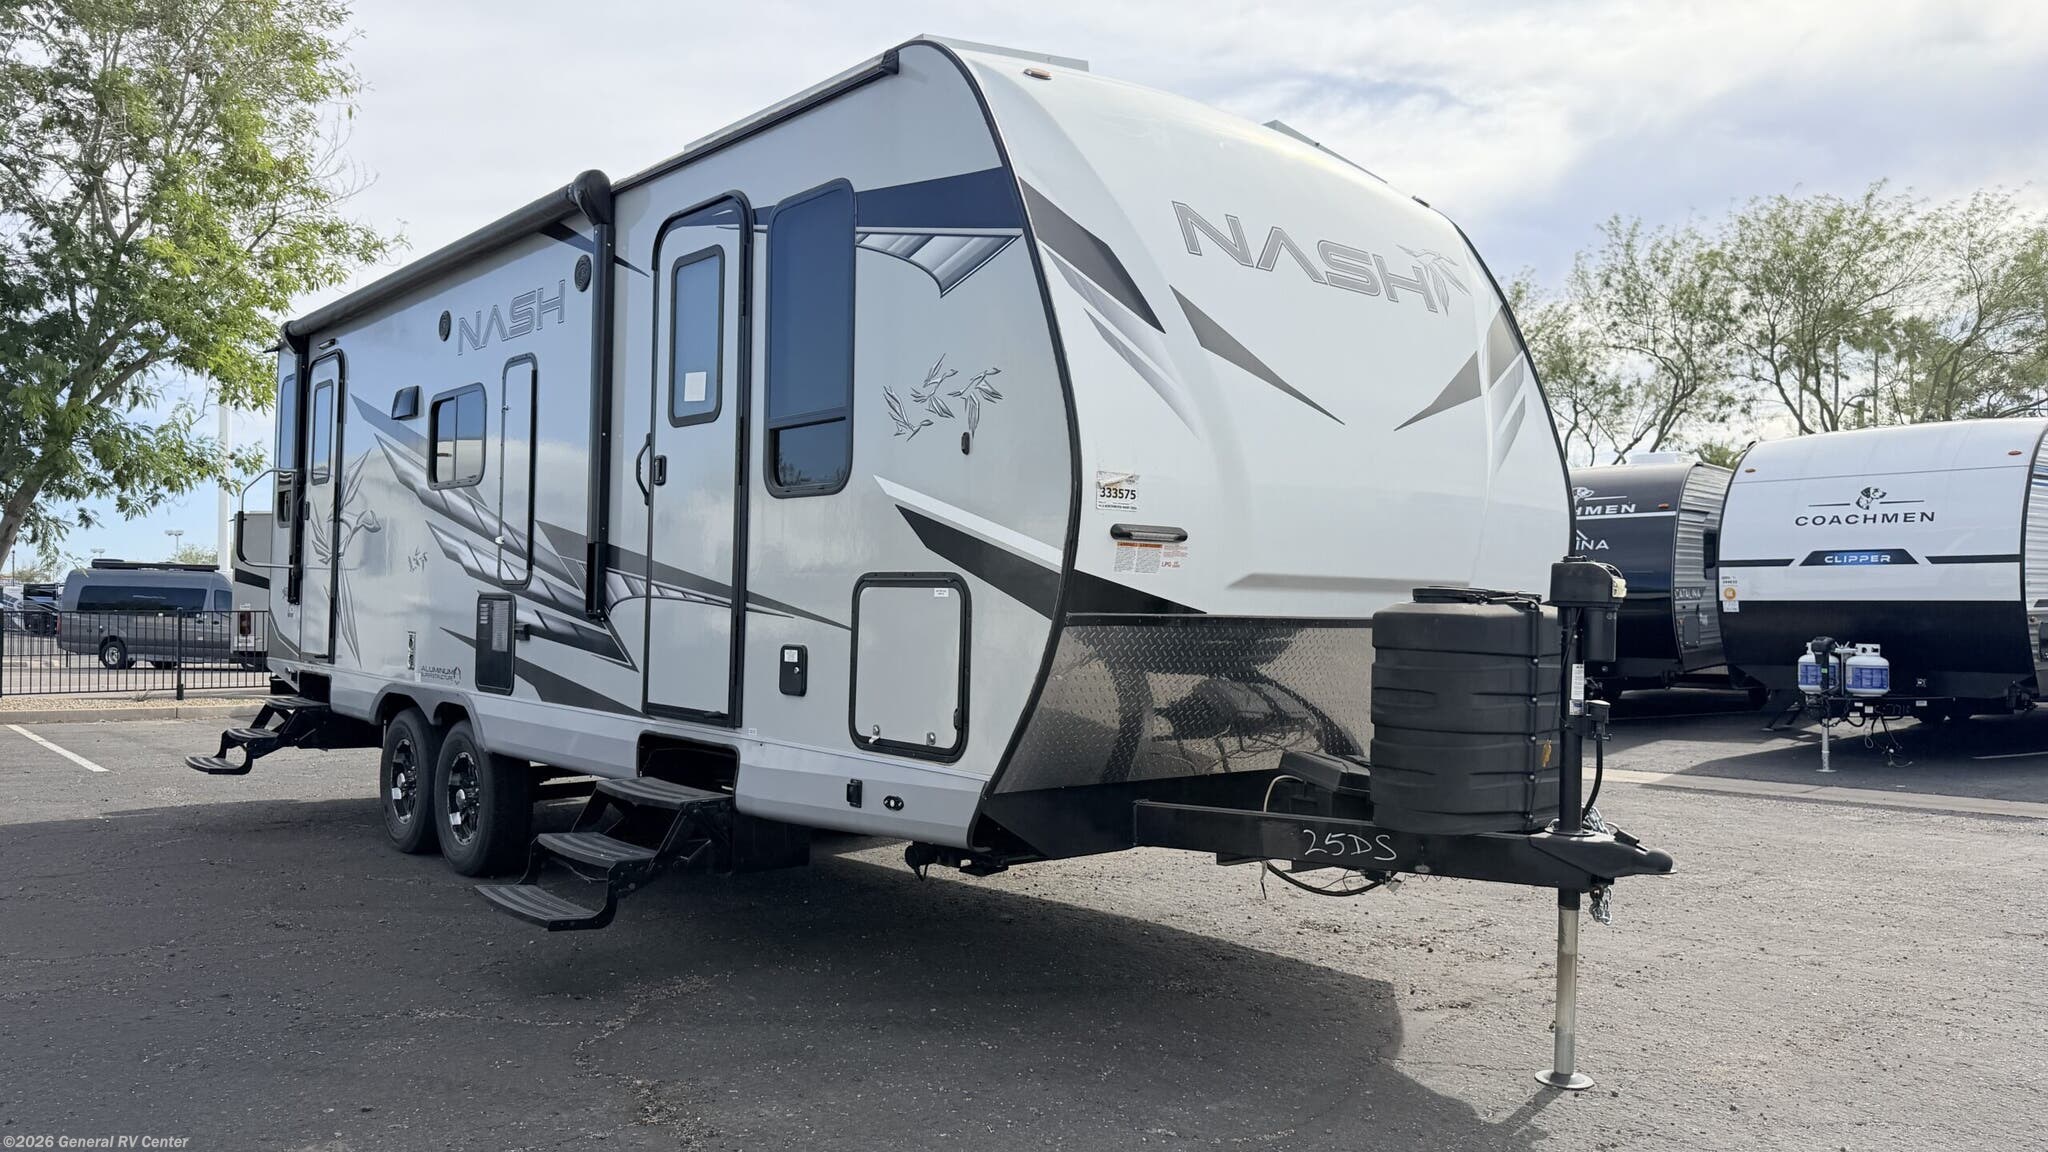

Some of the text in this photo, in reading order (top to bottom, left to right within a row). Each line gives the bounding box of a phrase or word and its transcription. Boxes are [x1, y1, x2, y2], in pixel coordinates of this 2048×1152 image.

[1172, 200, 1438, 313] NASH
[457, 279, 566, 356] NASH
[1099, 487, 1137, 500] 333575
[1795, 511, 1936, 527] COACHMEN
[1824, 554, 1892, 564] CLIPPER
[1674, 588, 1702, 600] CATALINA
[1303, 829, 1398, 861] 25DS
